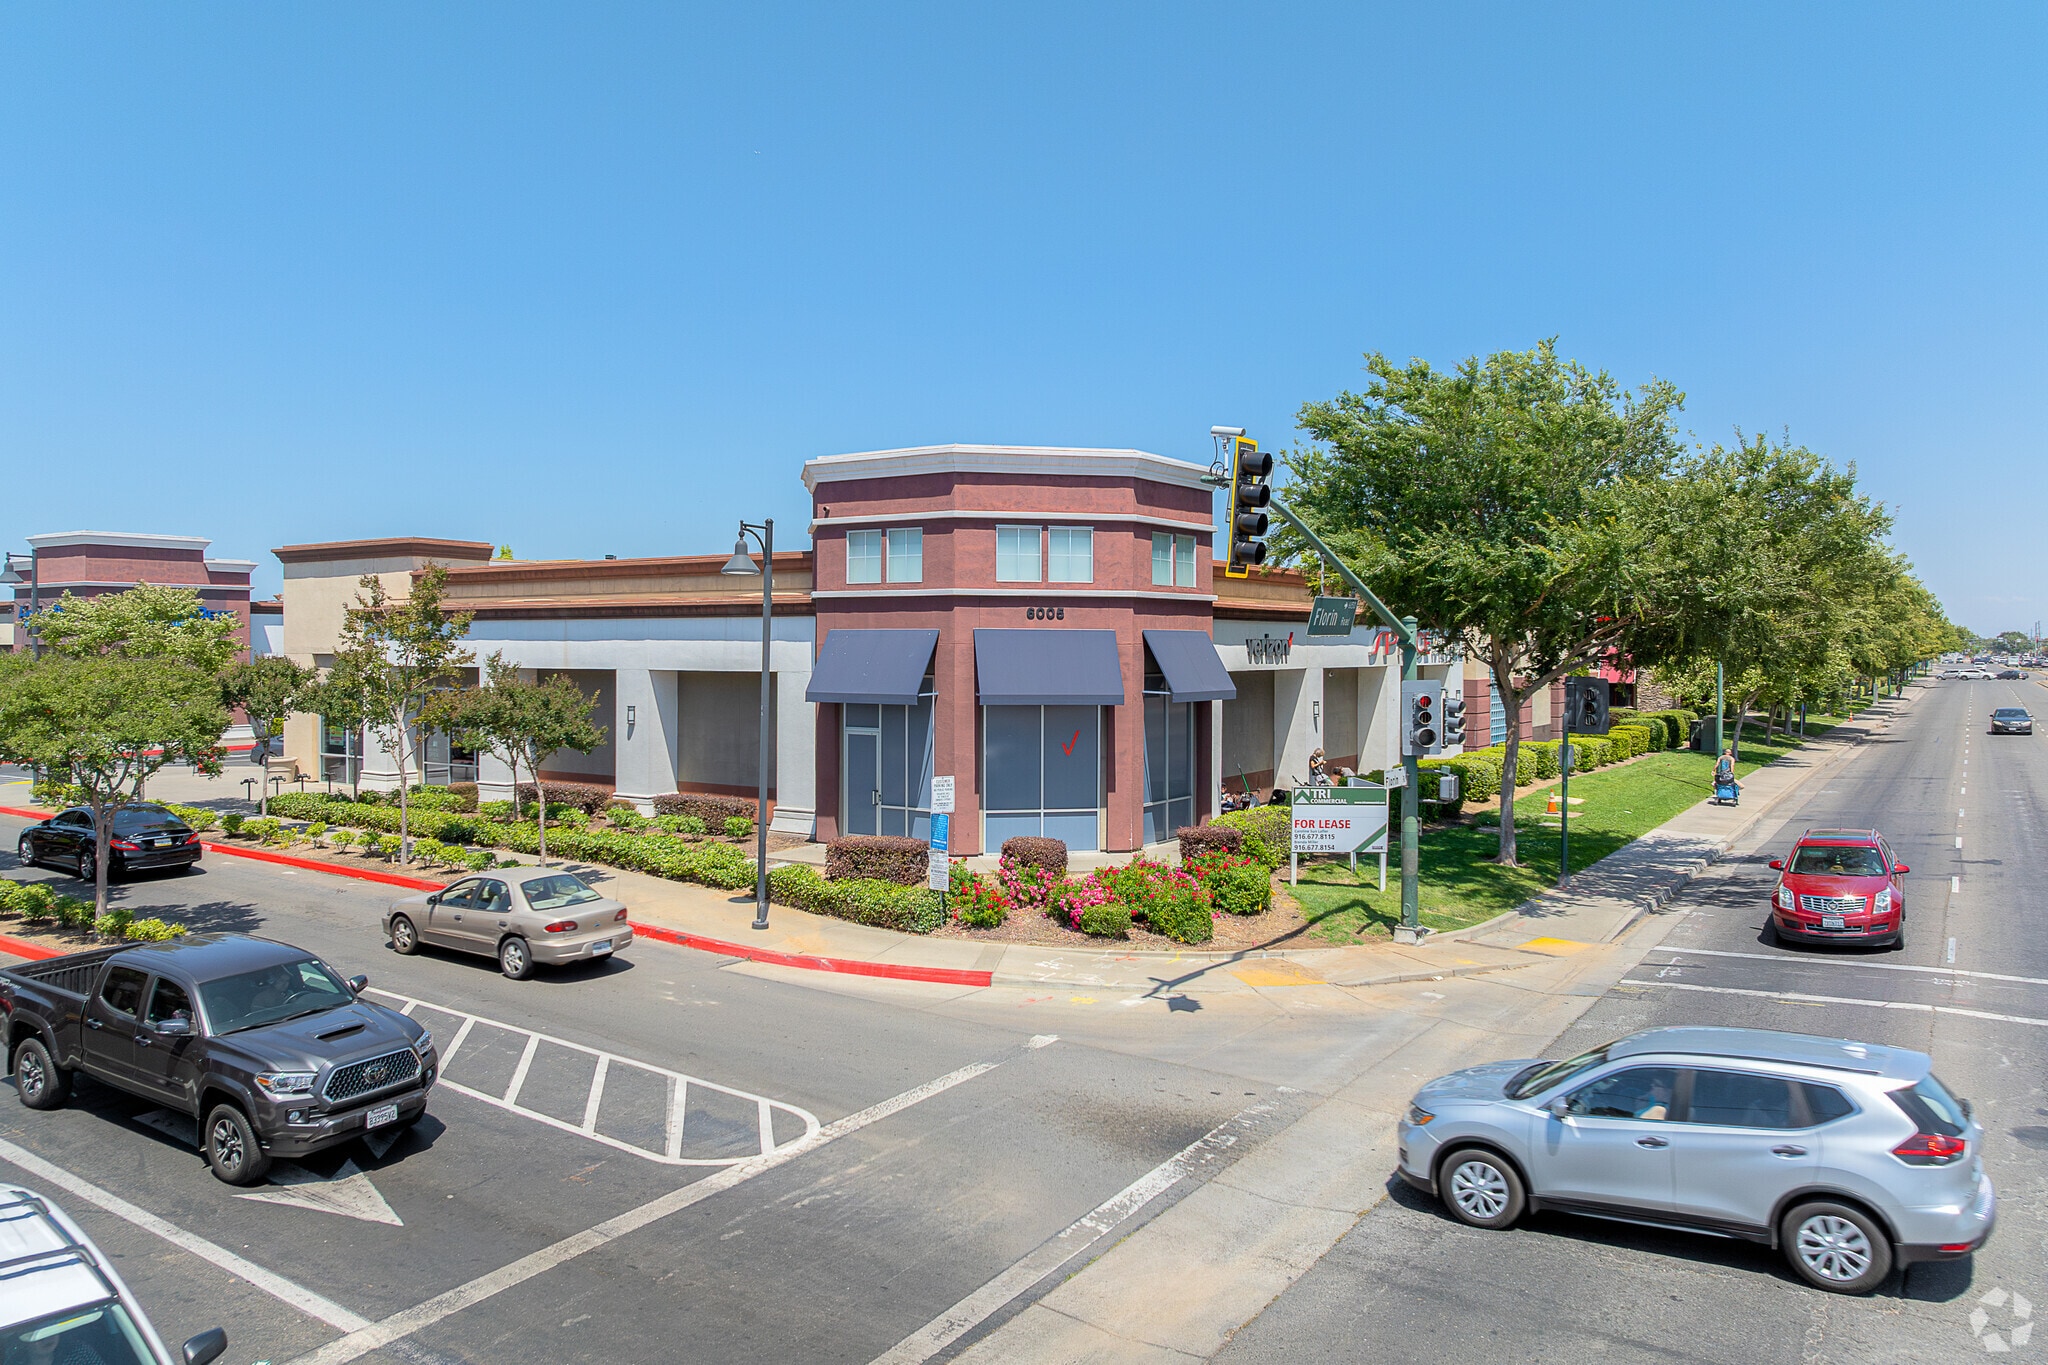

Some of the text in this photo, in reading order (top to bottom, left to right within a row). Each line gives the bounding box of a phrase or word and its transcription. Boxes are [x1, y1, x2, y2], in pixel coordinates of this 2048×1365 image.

[1026, 607, 1064, 621] 6005
[1313, 608, 1338, 626] Florin
[1246, 633, 1291, 658] verizon
[1311, 788, 1331, 799] TRI
[1294, 819, 1351, 829] FOR LEASE
